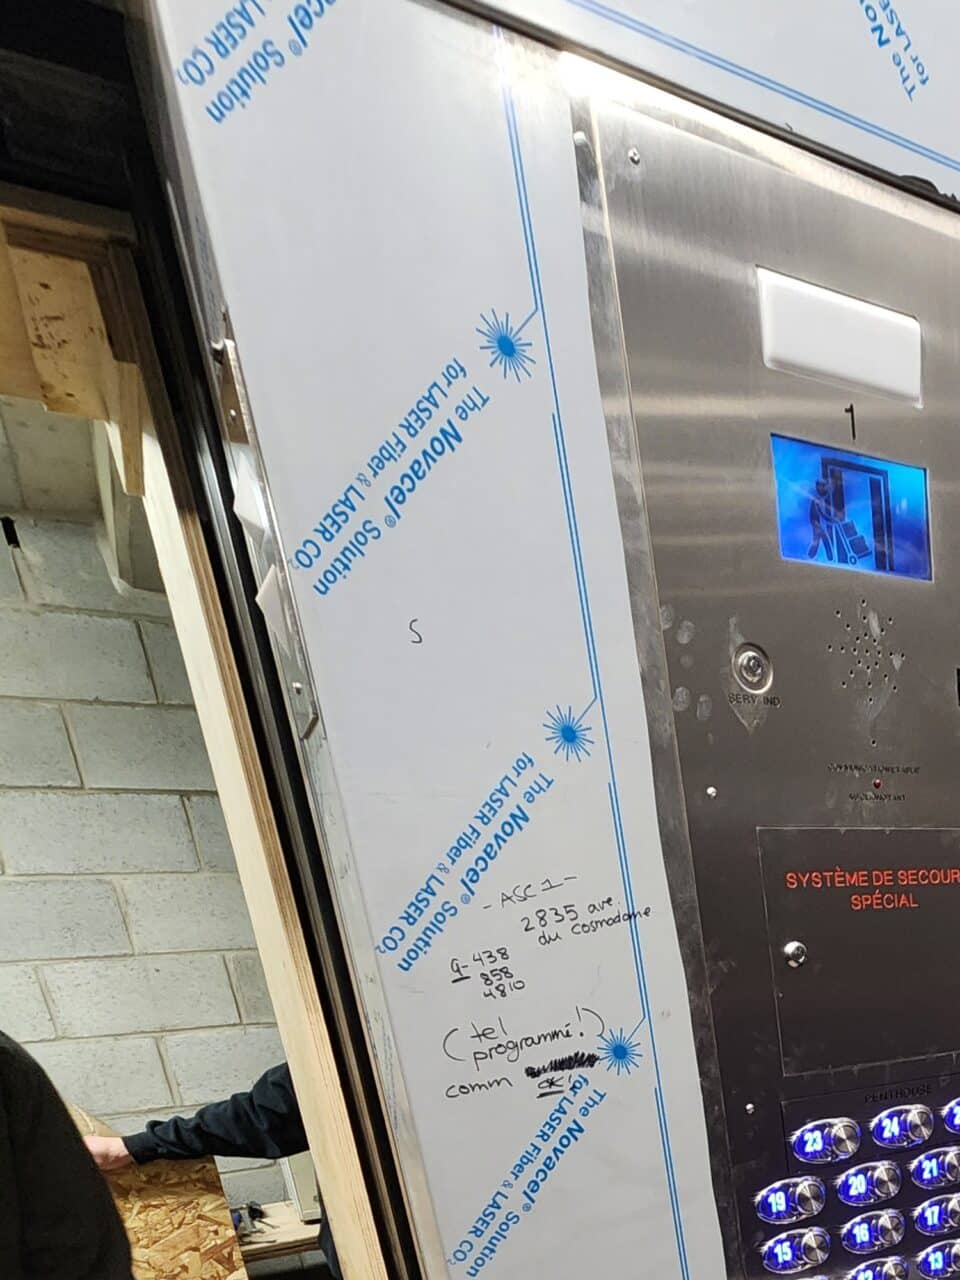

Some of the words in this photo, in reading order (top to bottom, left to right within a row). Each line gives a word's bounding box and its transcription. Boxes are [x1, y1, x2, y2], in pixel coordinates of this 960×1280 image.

[206, 40, 285, 123] Solution
[892, 52, 915, 101] The
[911, 55, 929, 85] for
[441, 357, 467, 388] for
[398, 381, 449, 438] LASER
[455, 385, 490, 421] The
[845, 403, 856, 440] 1
[367, 432, 408, 478] Fiber
[313, 484, 366, 542] LASER
[313, 519, 381, 596] Solution
[408, 618, 423, 644] S
[511, 752, 535, 778] for
[474, 775, 517, 826] LASER
[523, 772, 554, 804] The
[446, 823, 481, 866] Fiber
[786, 866, 869, 888] SYSTÈME
[872, 870, 894, 886] DE
[399, 873, 445, 927] LASER
[851, 889, 919, 910] SPÉCIAL
[521, 904, 579, 933] 2835
[397, 900, 458, 972] Solution
[538, 930, 562, 946] du
[472, 947, 510, 968] 438
[480, 966, 514, 987] 858
[483, 979, 526, 1000] 4810
[445, 1077, 513, 1099] comm
[569, 1074, 589, 1097] for
[864, 1083, 933, 1104] PENTHOUSE
[578, 1088, 607, 1117] The
[535, 1096, 574, 1143] LASER
[882, 1116, 901, 1138] 24
[804, 1131, 823, 1153] 23
[510, 1142, 542, 1181] Fiber
[922, 1158, 938, 1179] 21
[848, 1174, 866, 1196] 20
[468, 1190, 509, 1240] LASER
[767, 1192, 787, 1213] 19
[925, 1206, 941, 1226] 17
[466, 1210, 520, 1278] Solution
[852, 1223, 869, 1244] 16
[774, 1242, 792, 1263] 15
[928, 1252, 943, 1271] 13
